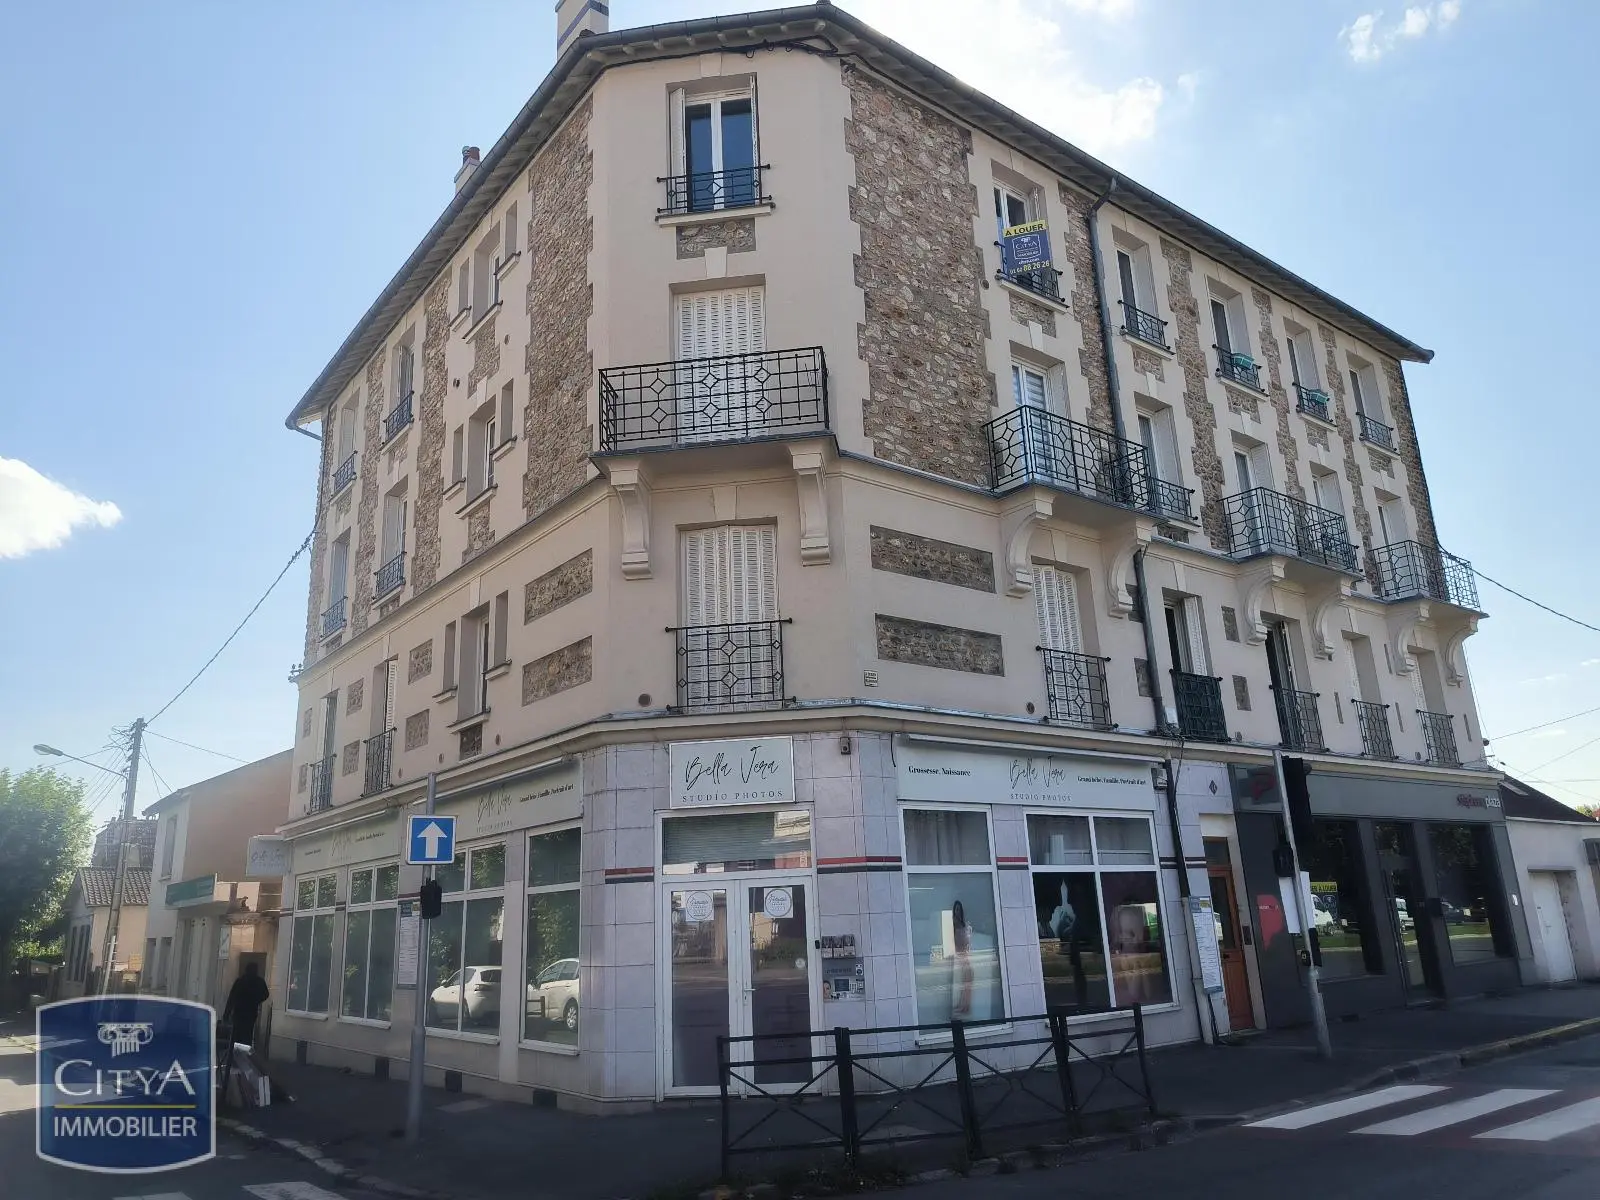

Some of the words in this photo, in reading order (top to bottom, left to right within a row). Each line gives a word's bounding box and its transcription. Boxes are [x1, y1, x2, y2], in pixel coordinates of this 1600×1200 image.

[1014, 224, 1044, 235] LOUER
[685, 752, 733, 791] Bella
[740, 745, 780, 784] Vera
[941, 767, 971, 777] Naissance
[1009, 757, 1038, 790] Bella
[1042, 755, 1066, 788] Vera
[682, 793, 728, 803] STUDIO
[735, 790, 784, 800] PHOTOS
[1010, 793, 1039, 801] STUDIO
[1042, 794, 1072, 802] PHOTOS
[1485, 796, 1501, 808] plaza
